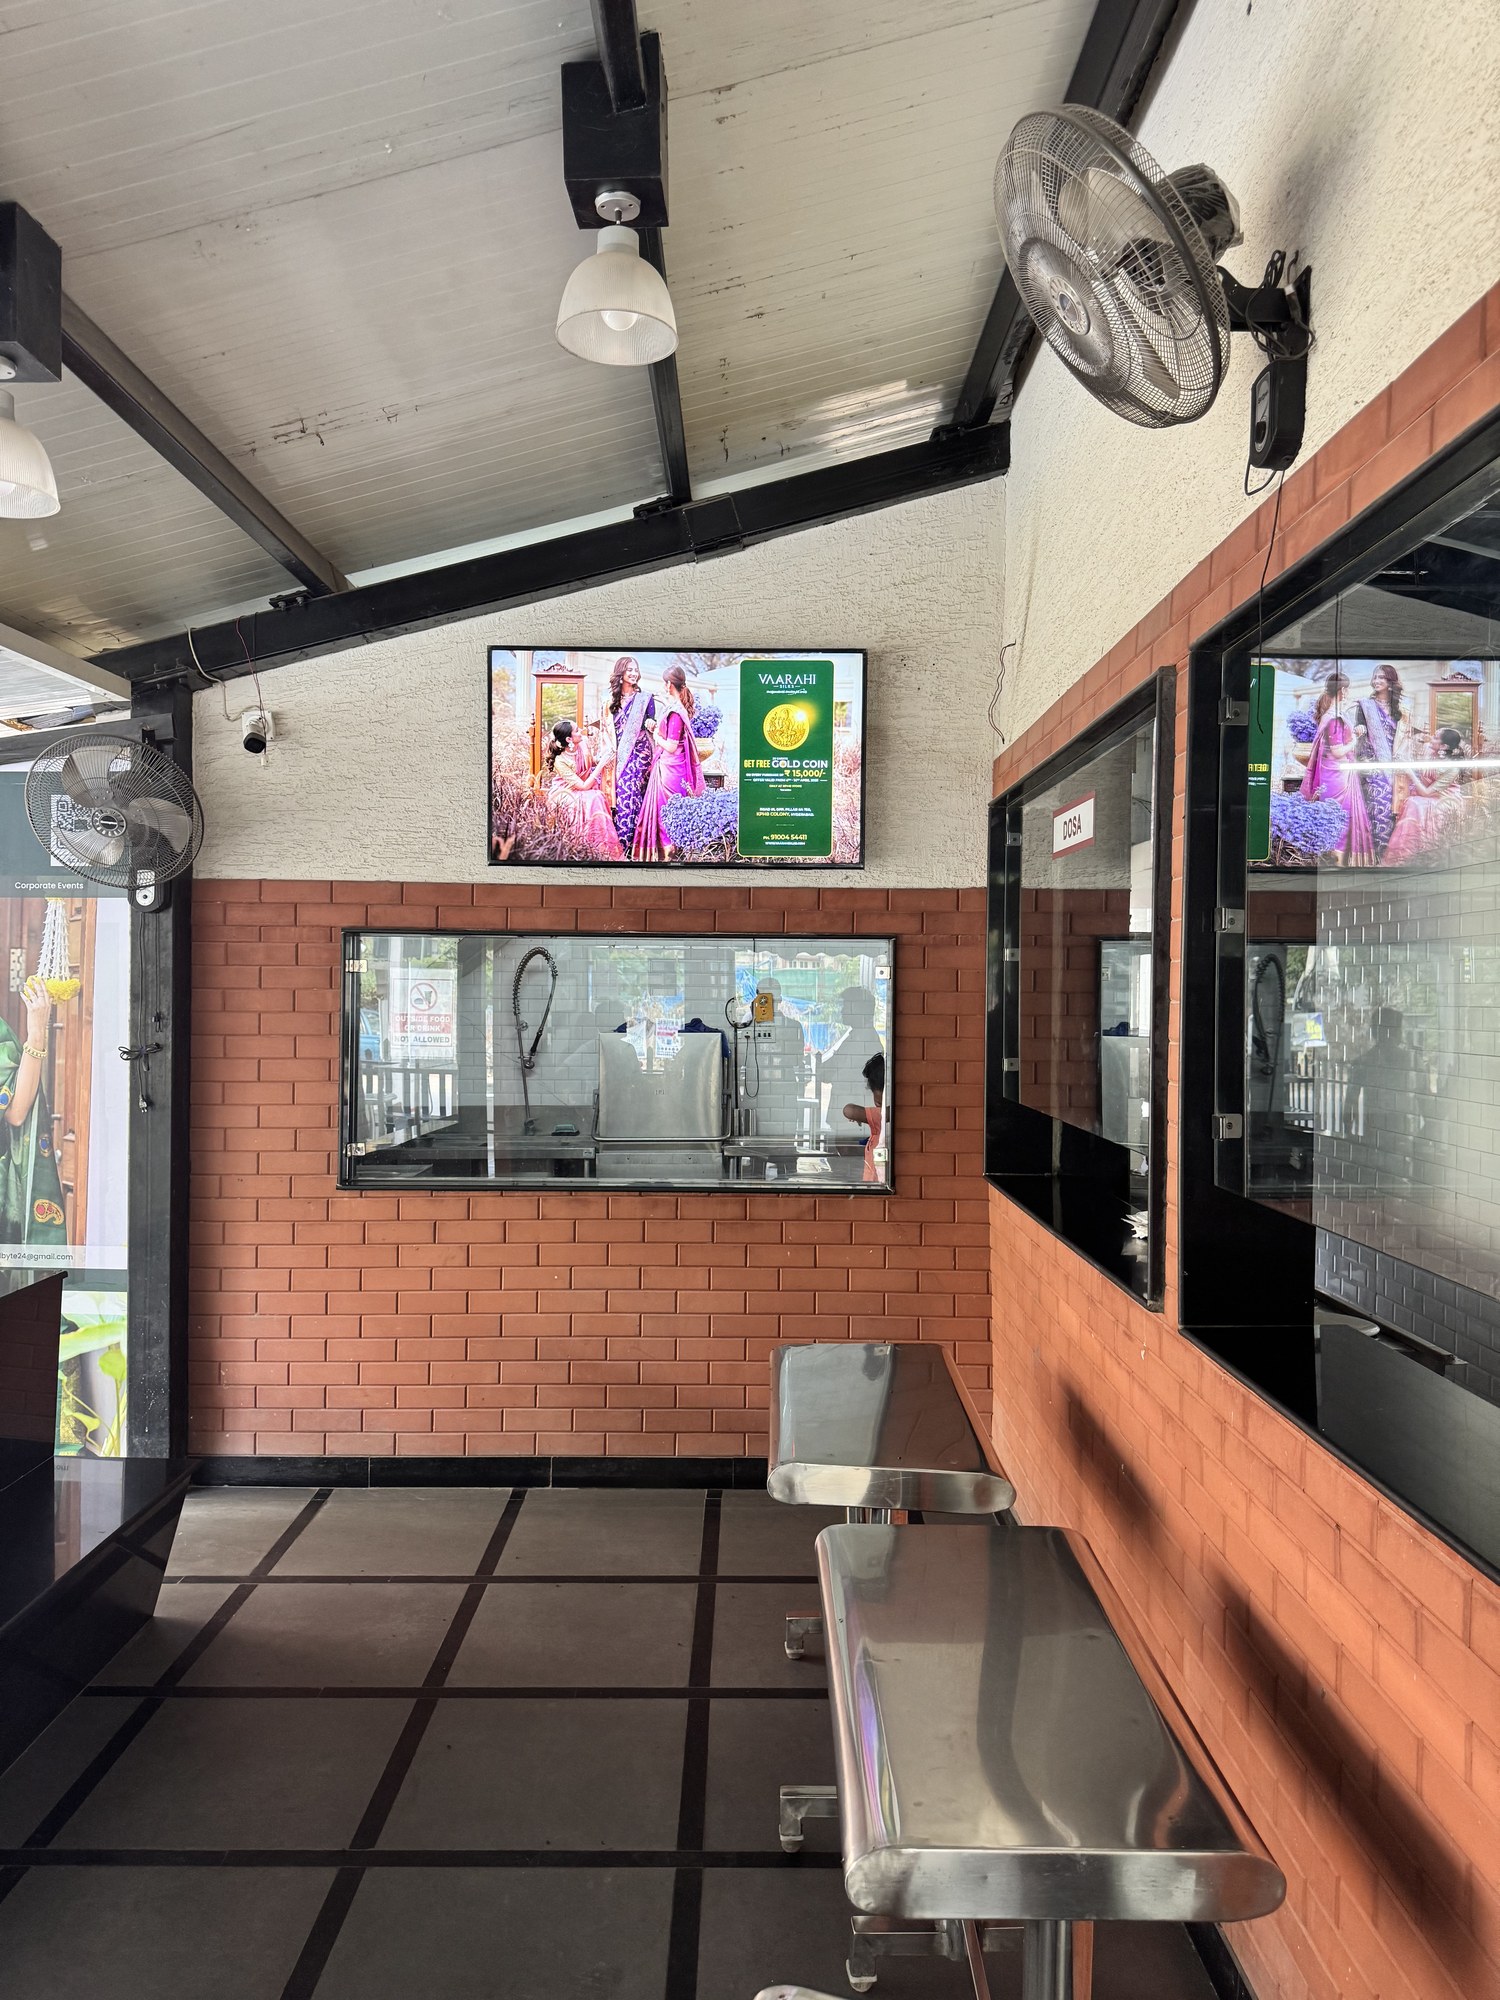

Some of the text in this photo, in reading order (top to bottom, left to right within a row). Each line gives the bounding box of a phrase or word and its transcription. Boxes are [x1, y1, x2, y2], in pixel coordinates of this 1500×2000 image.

[758, 673, 817, 685] VAARAHI
[743, 759, 828, 769] GET FREE GOLD COIN
[792, 769, 826, 778] 15,000/-
[1062, 813, 1082, 841] DOSA
[770, 833, 790, 841] 91004
[14, 881, 84, 891] Corporate Events
[429, 1015, 451, 1023] FOOD
[404, 1024, 441, 1032] OR DRINK
